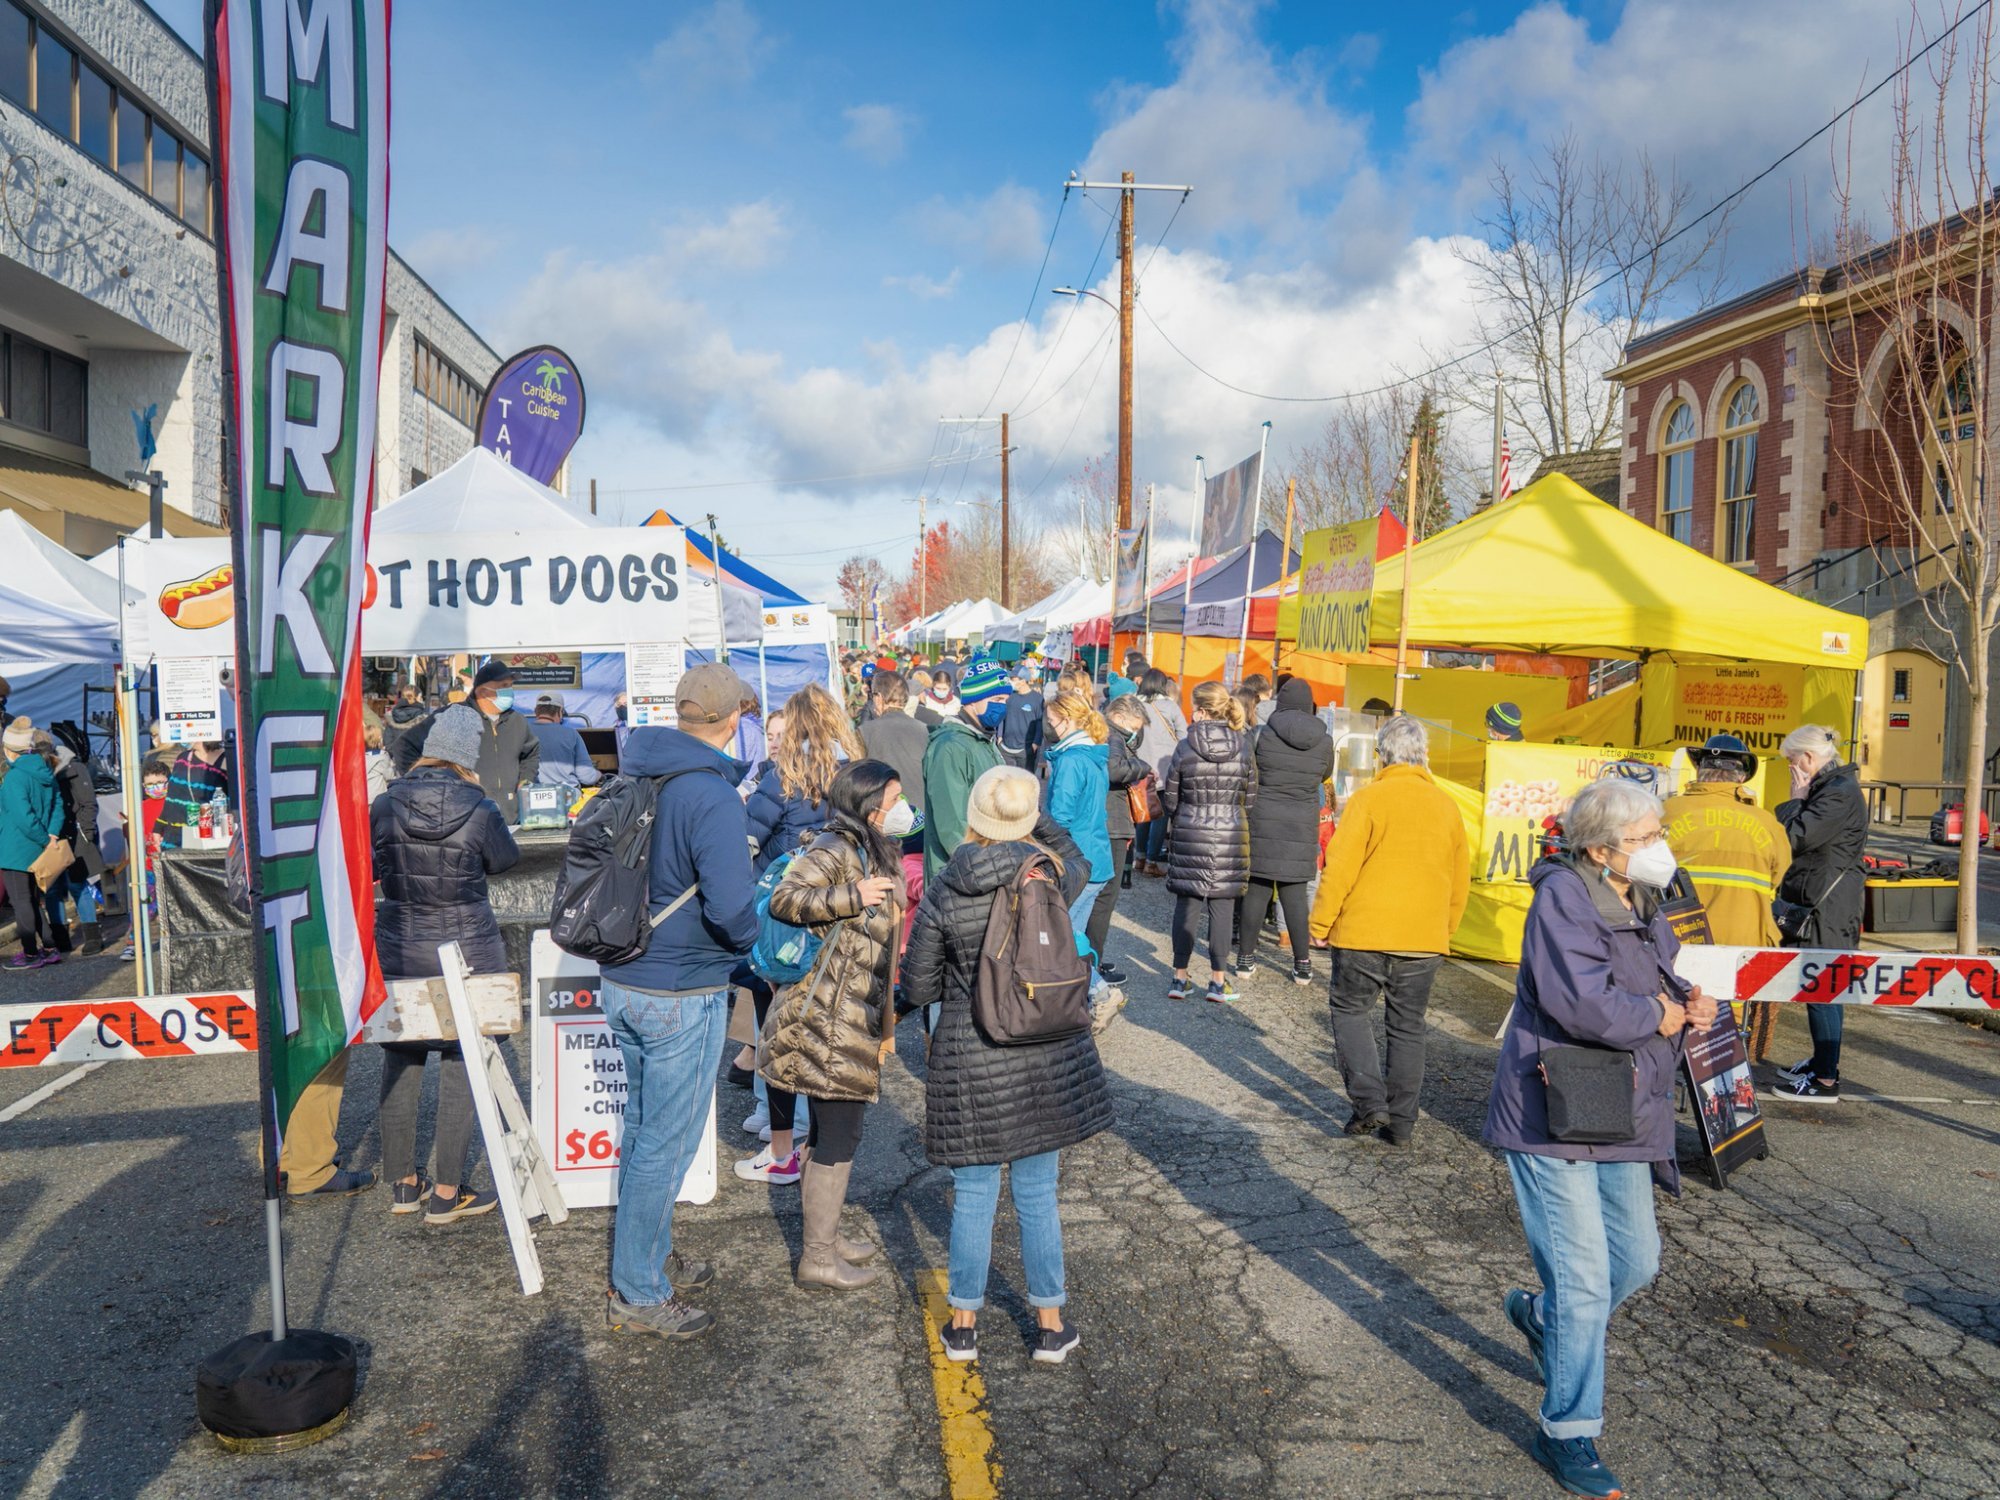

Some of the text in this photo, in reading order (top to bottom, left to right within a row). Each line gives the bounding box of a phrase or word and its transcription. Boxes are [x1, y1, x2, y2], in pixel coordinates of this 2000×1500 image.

[527, 400, 560, 420] Cuisine
[495, 397, 512, 465] TAM
[1944, 425, 1975, 442] MUS
[257, 0, 359, 1037] MARKET
[428, 557, 532, 608] HOT
[549, 552, 679, 606] DOGS
[1323, 599, 1370, 653] DONUTS
[1715, 668, 1760, 678] Little Jamie's
[1704, 709, 1765, 725] HOT & FRESH
[1674, 724, 1712, 743] MINI
[1600, 749, 1655, 760] Little Jamie's
[1577, 758, 1608, 780] HO
[535, 791, 553, 800] TIPS
[1705, 807, 1773, 850] DISTRICT
[1714, 829, 1720, 848] 1
[1486, 818, 1535, 882] Mi
[1800, 962, 2000, 999] STREET CL
[548, 989, 602, 1009] SPOT
[10, 1004, 251, 1055] ET CLOSE
[565, 1032, 621, 1050] MEAL
[593, 1059, 624, 1073] Hot
[593, 1080, 628, 1093] Drin
[565, 1128, 621, 1164] $6.
